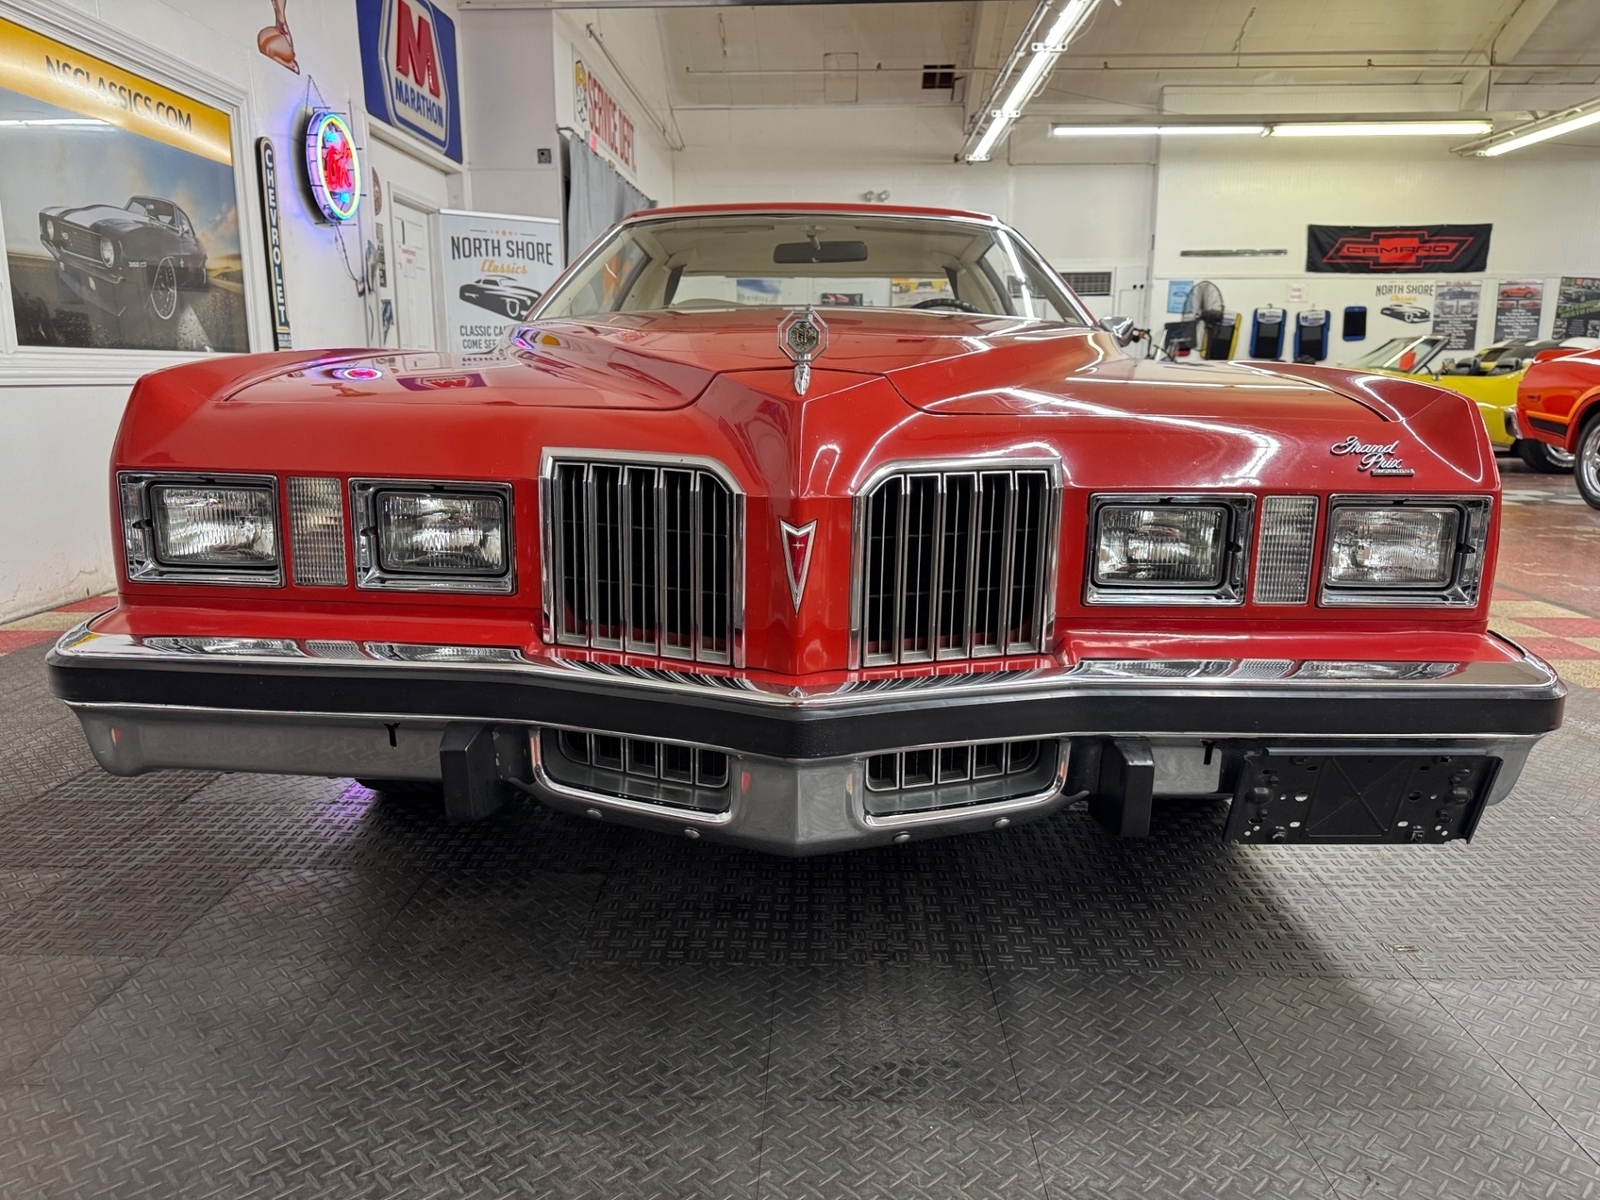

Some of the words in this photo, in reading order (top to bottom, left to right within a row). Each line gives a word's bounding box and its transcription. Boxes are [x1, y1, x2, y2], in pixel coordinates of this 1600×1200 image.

[45, 54, 193, 134] NSCLASSICS.COM
[395, 77, 444, 128] MARATHON
[588, 70, 618, 156] SERVICE
[265, 149, 287, 323] CHEVROLET
[451, 236, 501, 260] NORTH
[506, 240, 554, 266] SHORE
[1346, 245, 1450, 255] CAMARO
[480, 258, 528, 275] Classics
[1376, 284, 1404, 297] NORTH
[1405, 284, 1434, 297] SHORE
[460, 325, 492, 337] CLASSIC
[463, 339, 483, 349] COME
[1331, 435, 1399, 455] Grand
[1359, 452, 1404, 470] Prix
